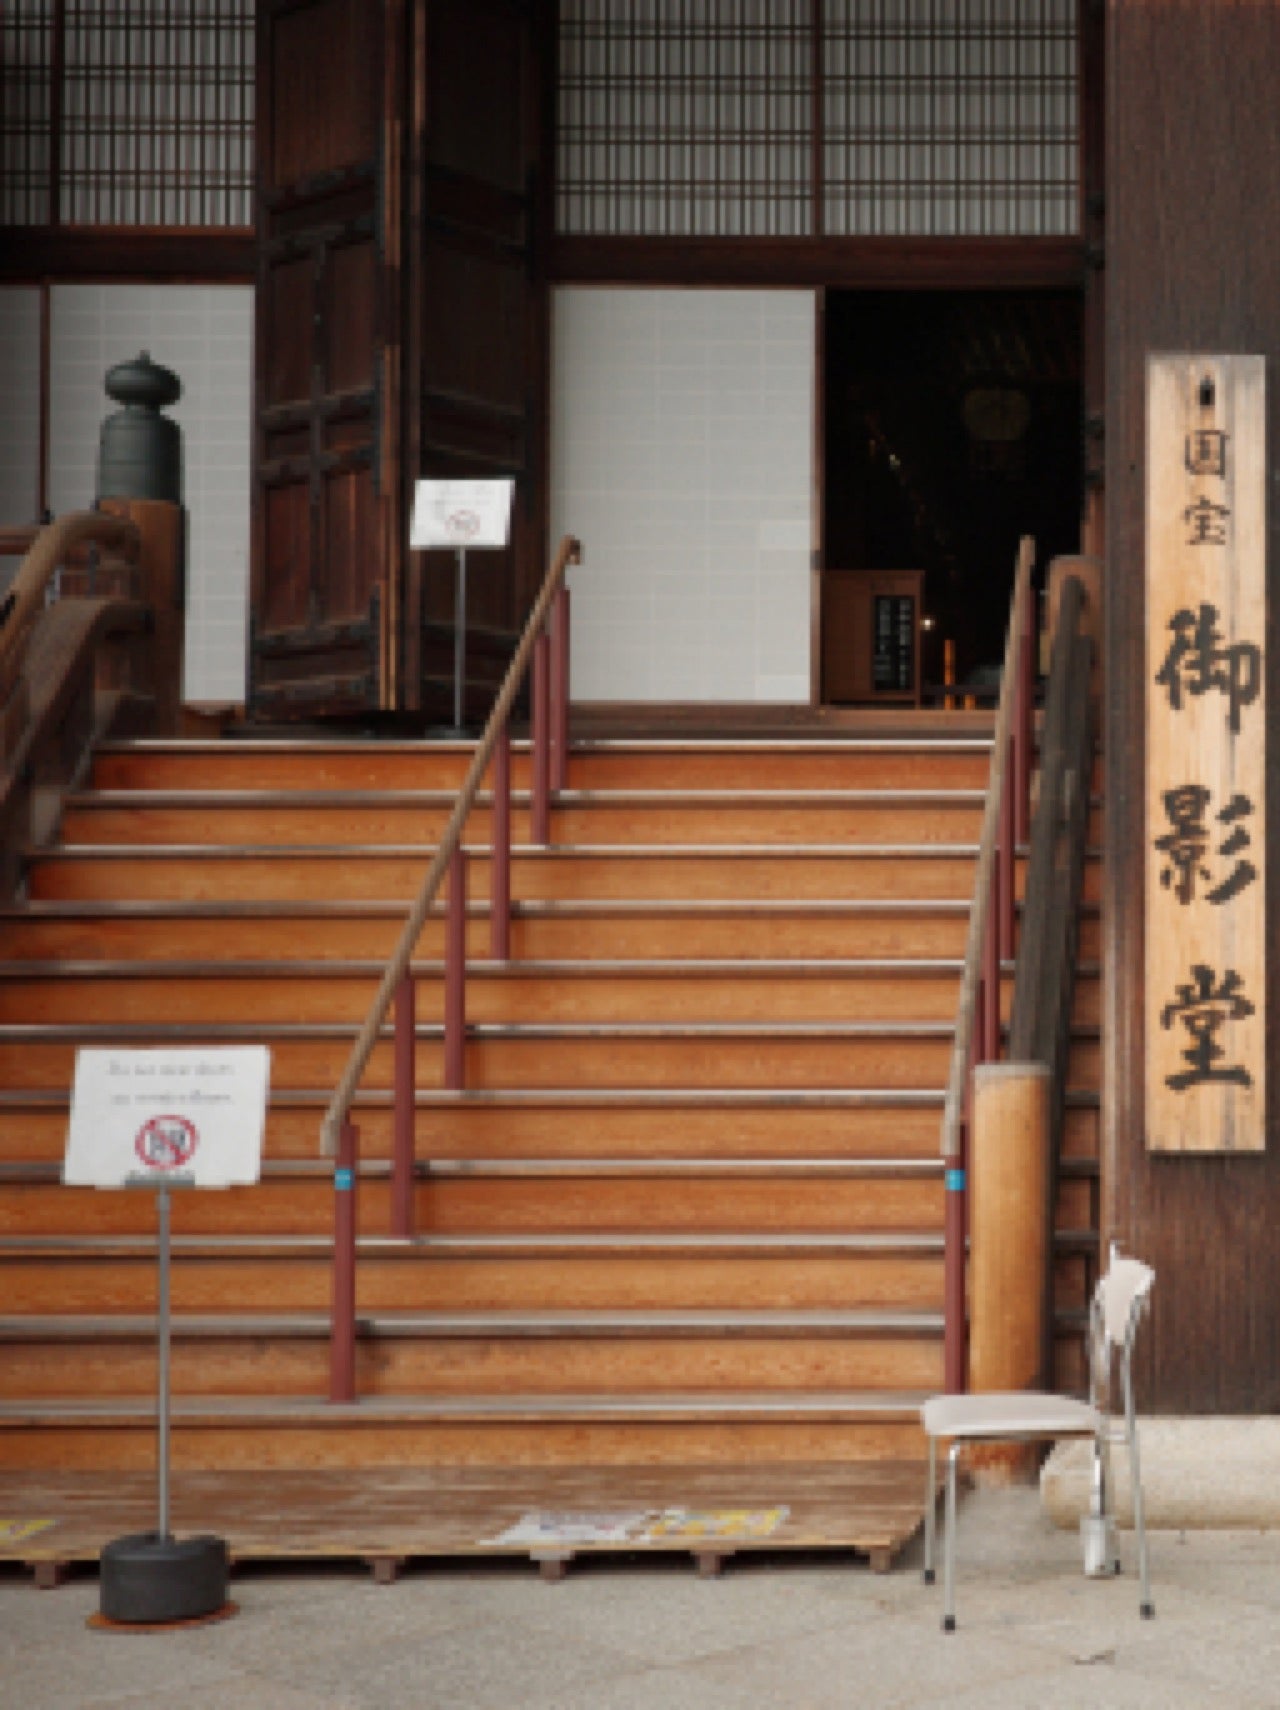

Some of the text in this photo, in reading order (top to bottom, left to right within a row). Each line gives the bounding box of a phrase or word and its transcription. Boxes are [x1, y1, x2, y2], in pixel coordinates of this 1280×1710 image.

[1155, 429, 1261, 1090] 国宝 御影堂
